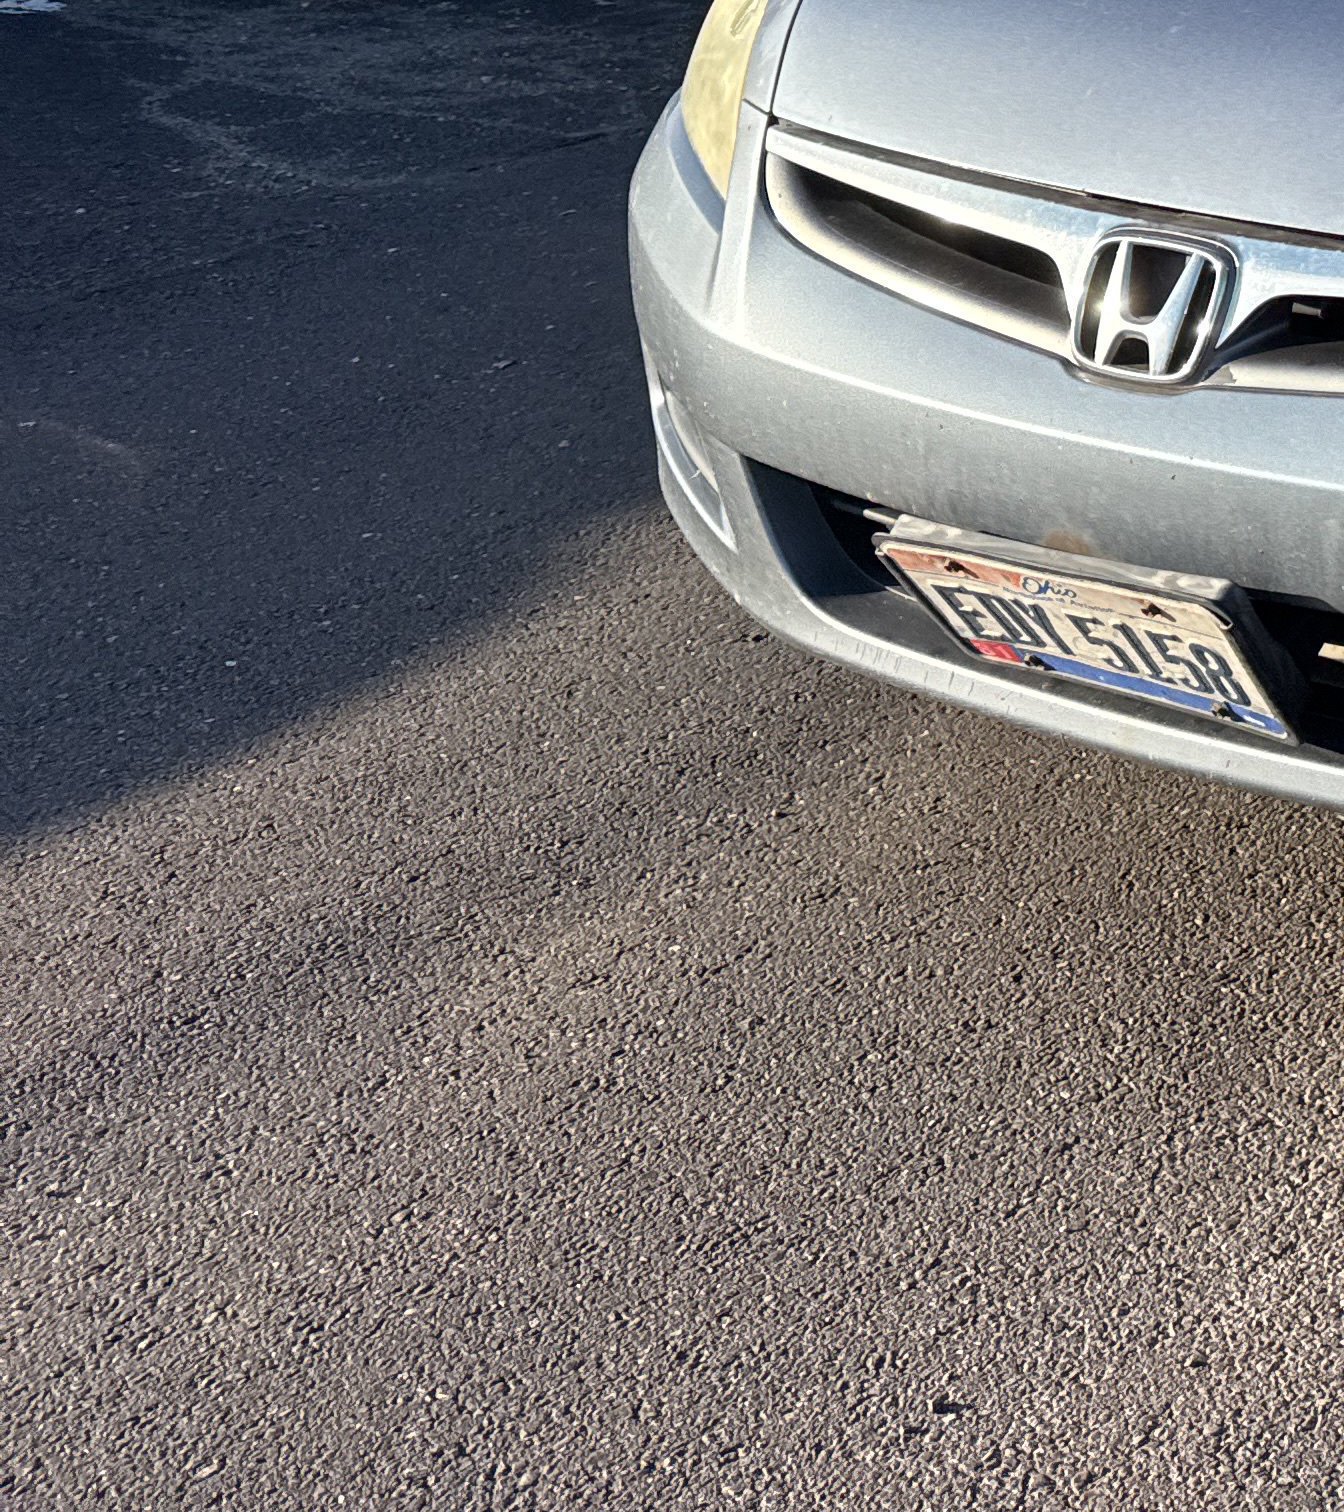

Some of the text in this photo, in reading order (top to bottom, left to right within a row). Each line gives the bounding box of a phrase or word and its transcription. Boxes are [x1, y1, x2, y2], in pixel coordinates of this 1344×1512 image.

[1022, 576, 1078, 599] Ohio
[931, 583, 1252, 707] EDY 5158
